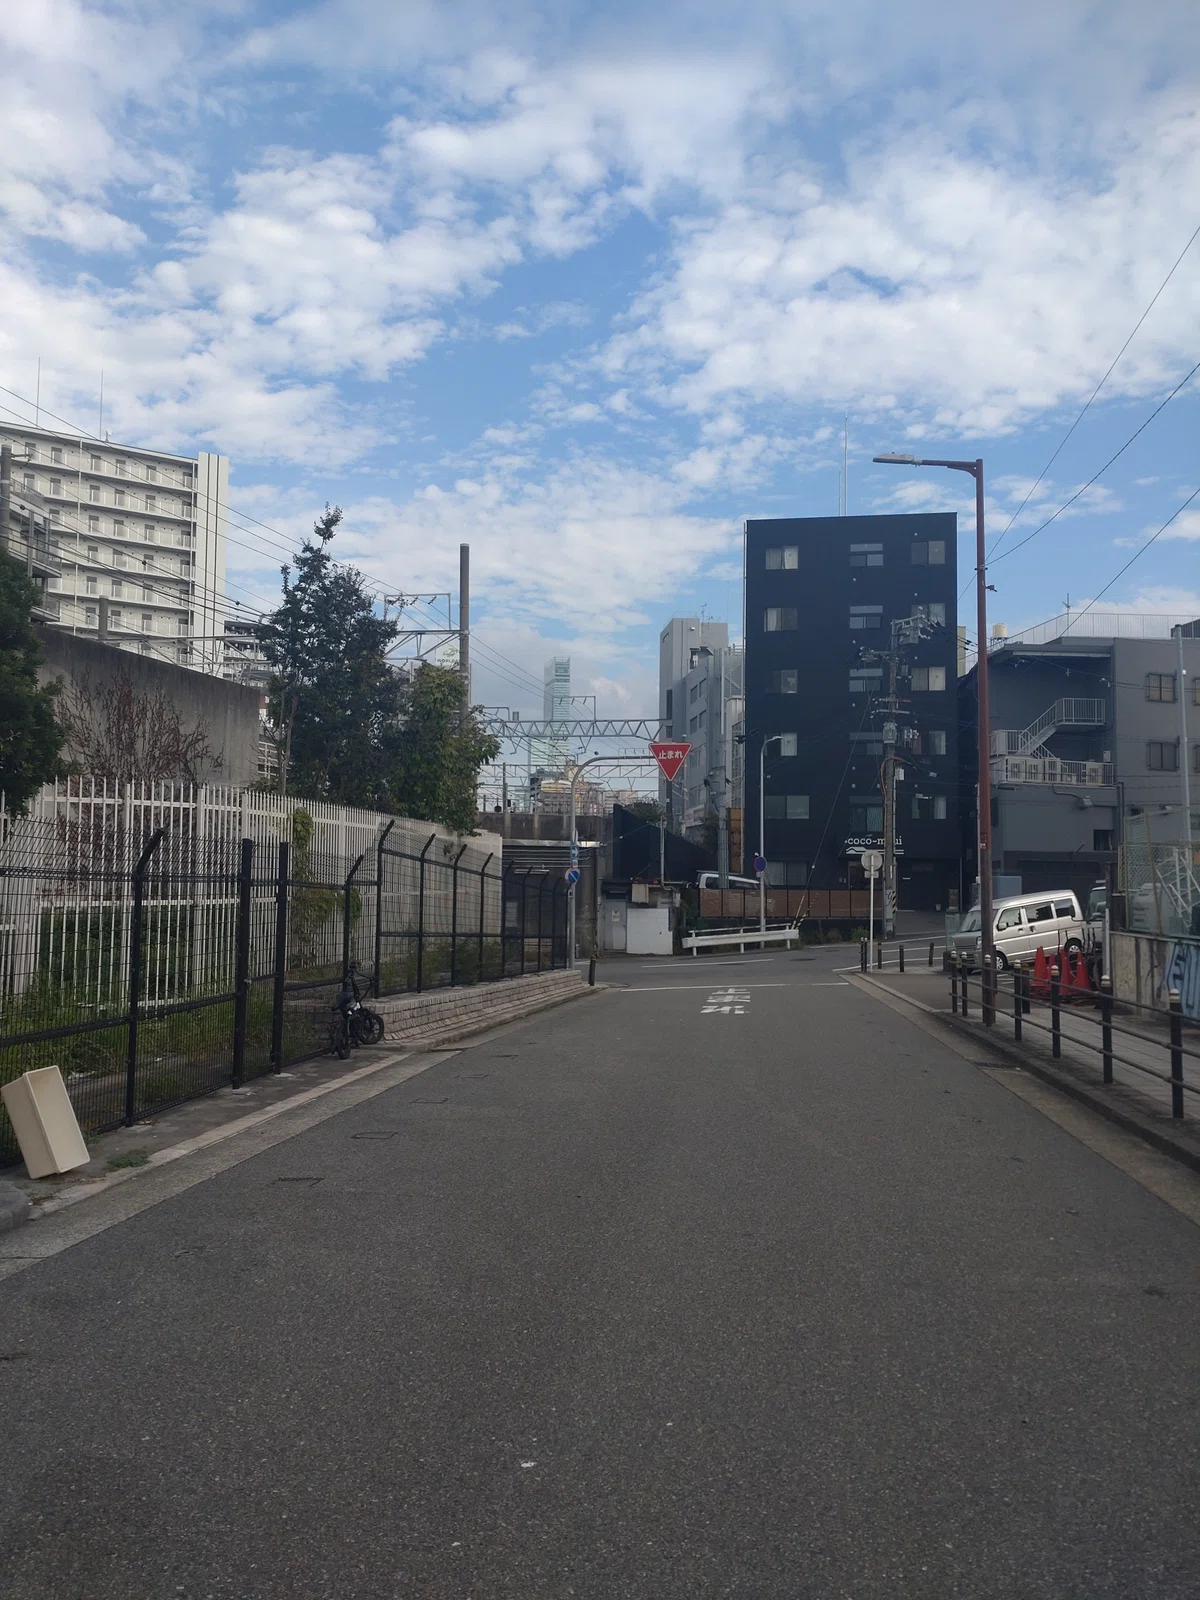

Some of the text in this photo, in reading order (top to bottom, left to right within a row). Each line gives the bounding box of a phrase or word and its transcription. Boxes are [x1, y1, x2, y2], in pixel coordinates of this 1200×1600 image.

[658, 750, 684, 760] 止まれ
[847, 835, 903, 845] coco-mui
